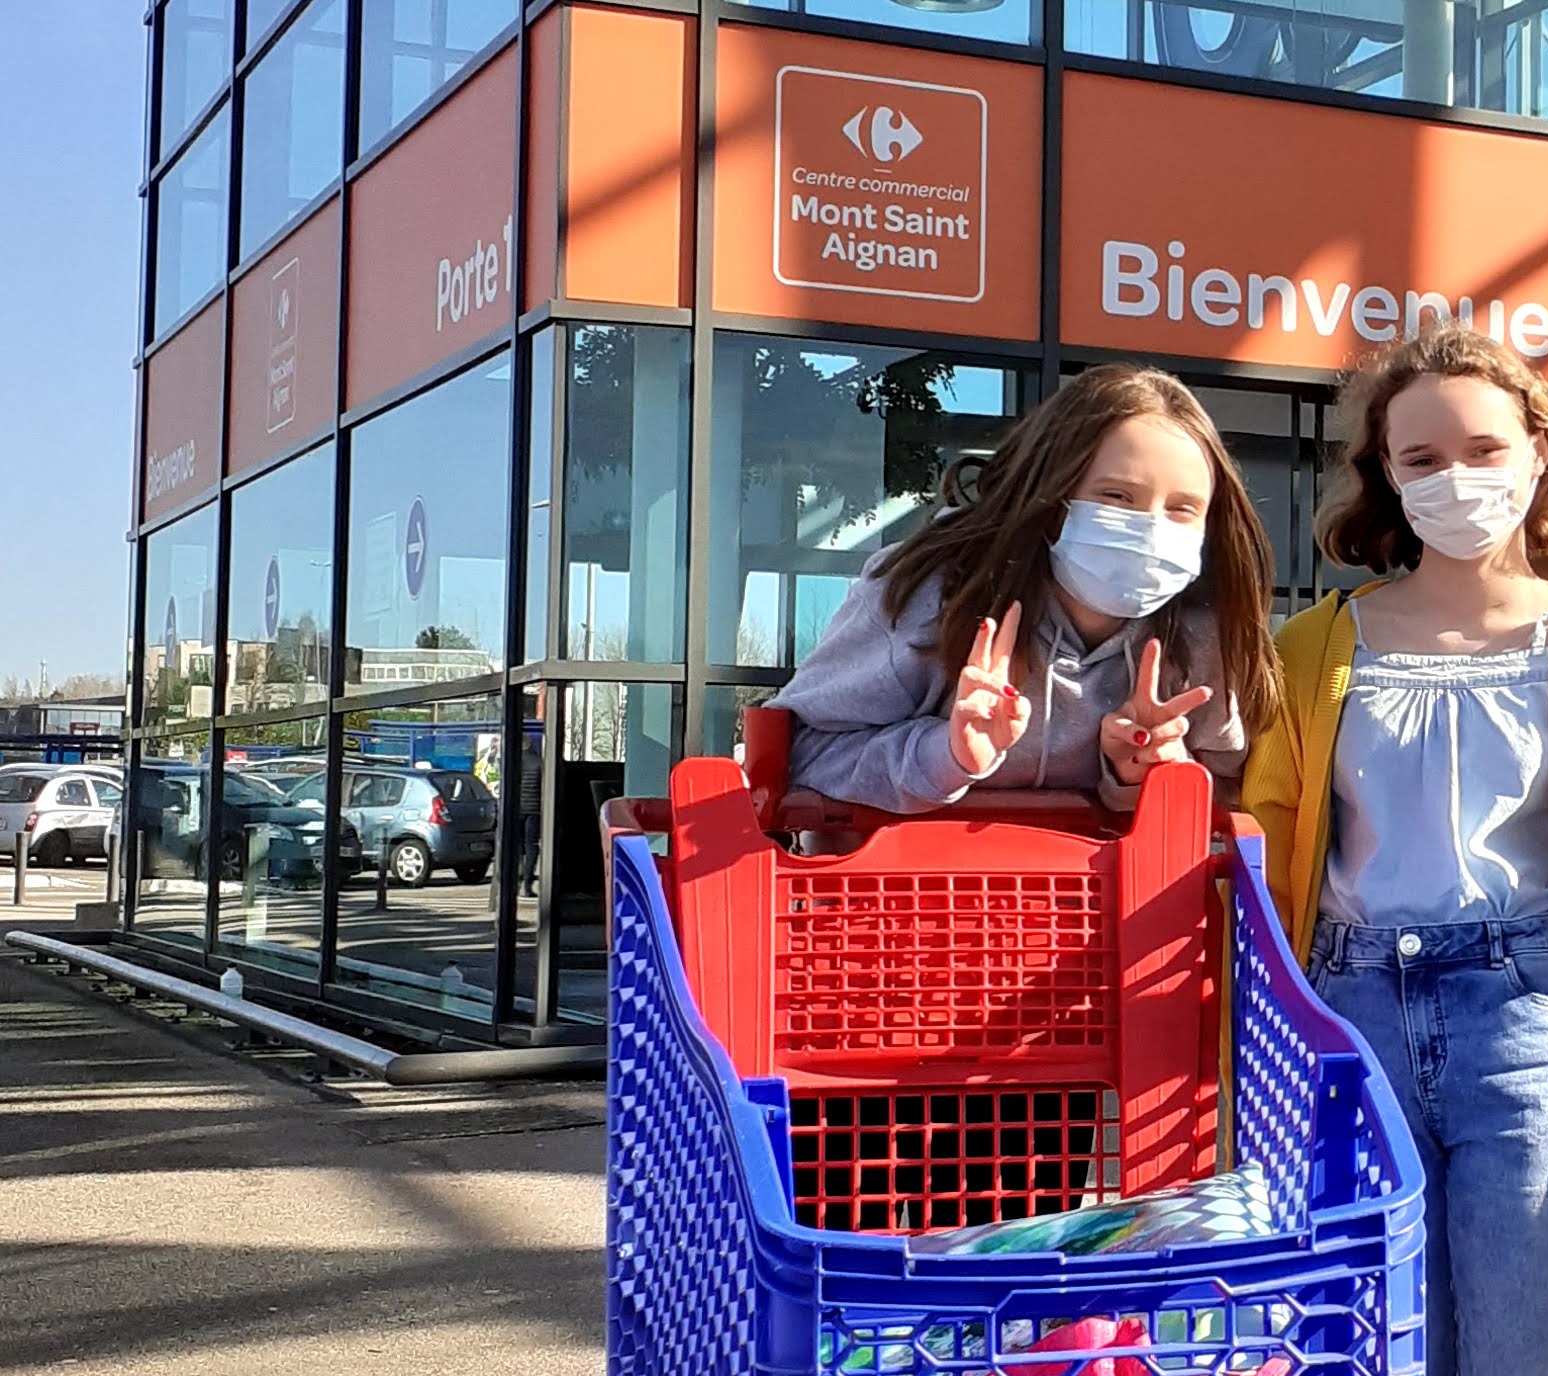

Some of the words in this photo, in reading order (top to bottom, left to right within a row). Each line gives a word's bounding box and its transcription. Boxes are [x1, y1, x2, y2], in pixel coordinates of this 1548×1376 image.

[792, 167, 855, 189] Centre
[859, 177, 970, 202] commercial
[791, 194, 878, 230] Mont
[884, 204, 970, 240] Saint
[436, 239, 498, 332] Porte
[503, 213, 513, 292] 1
[822, 232, 938, 271] Aignan
